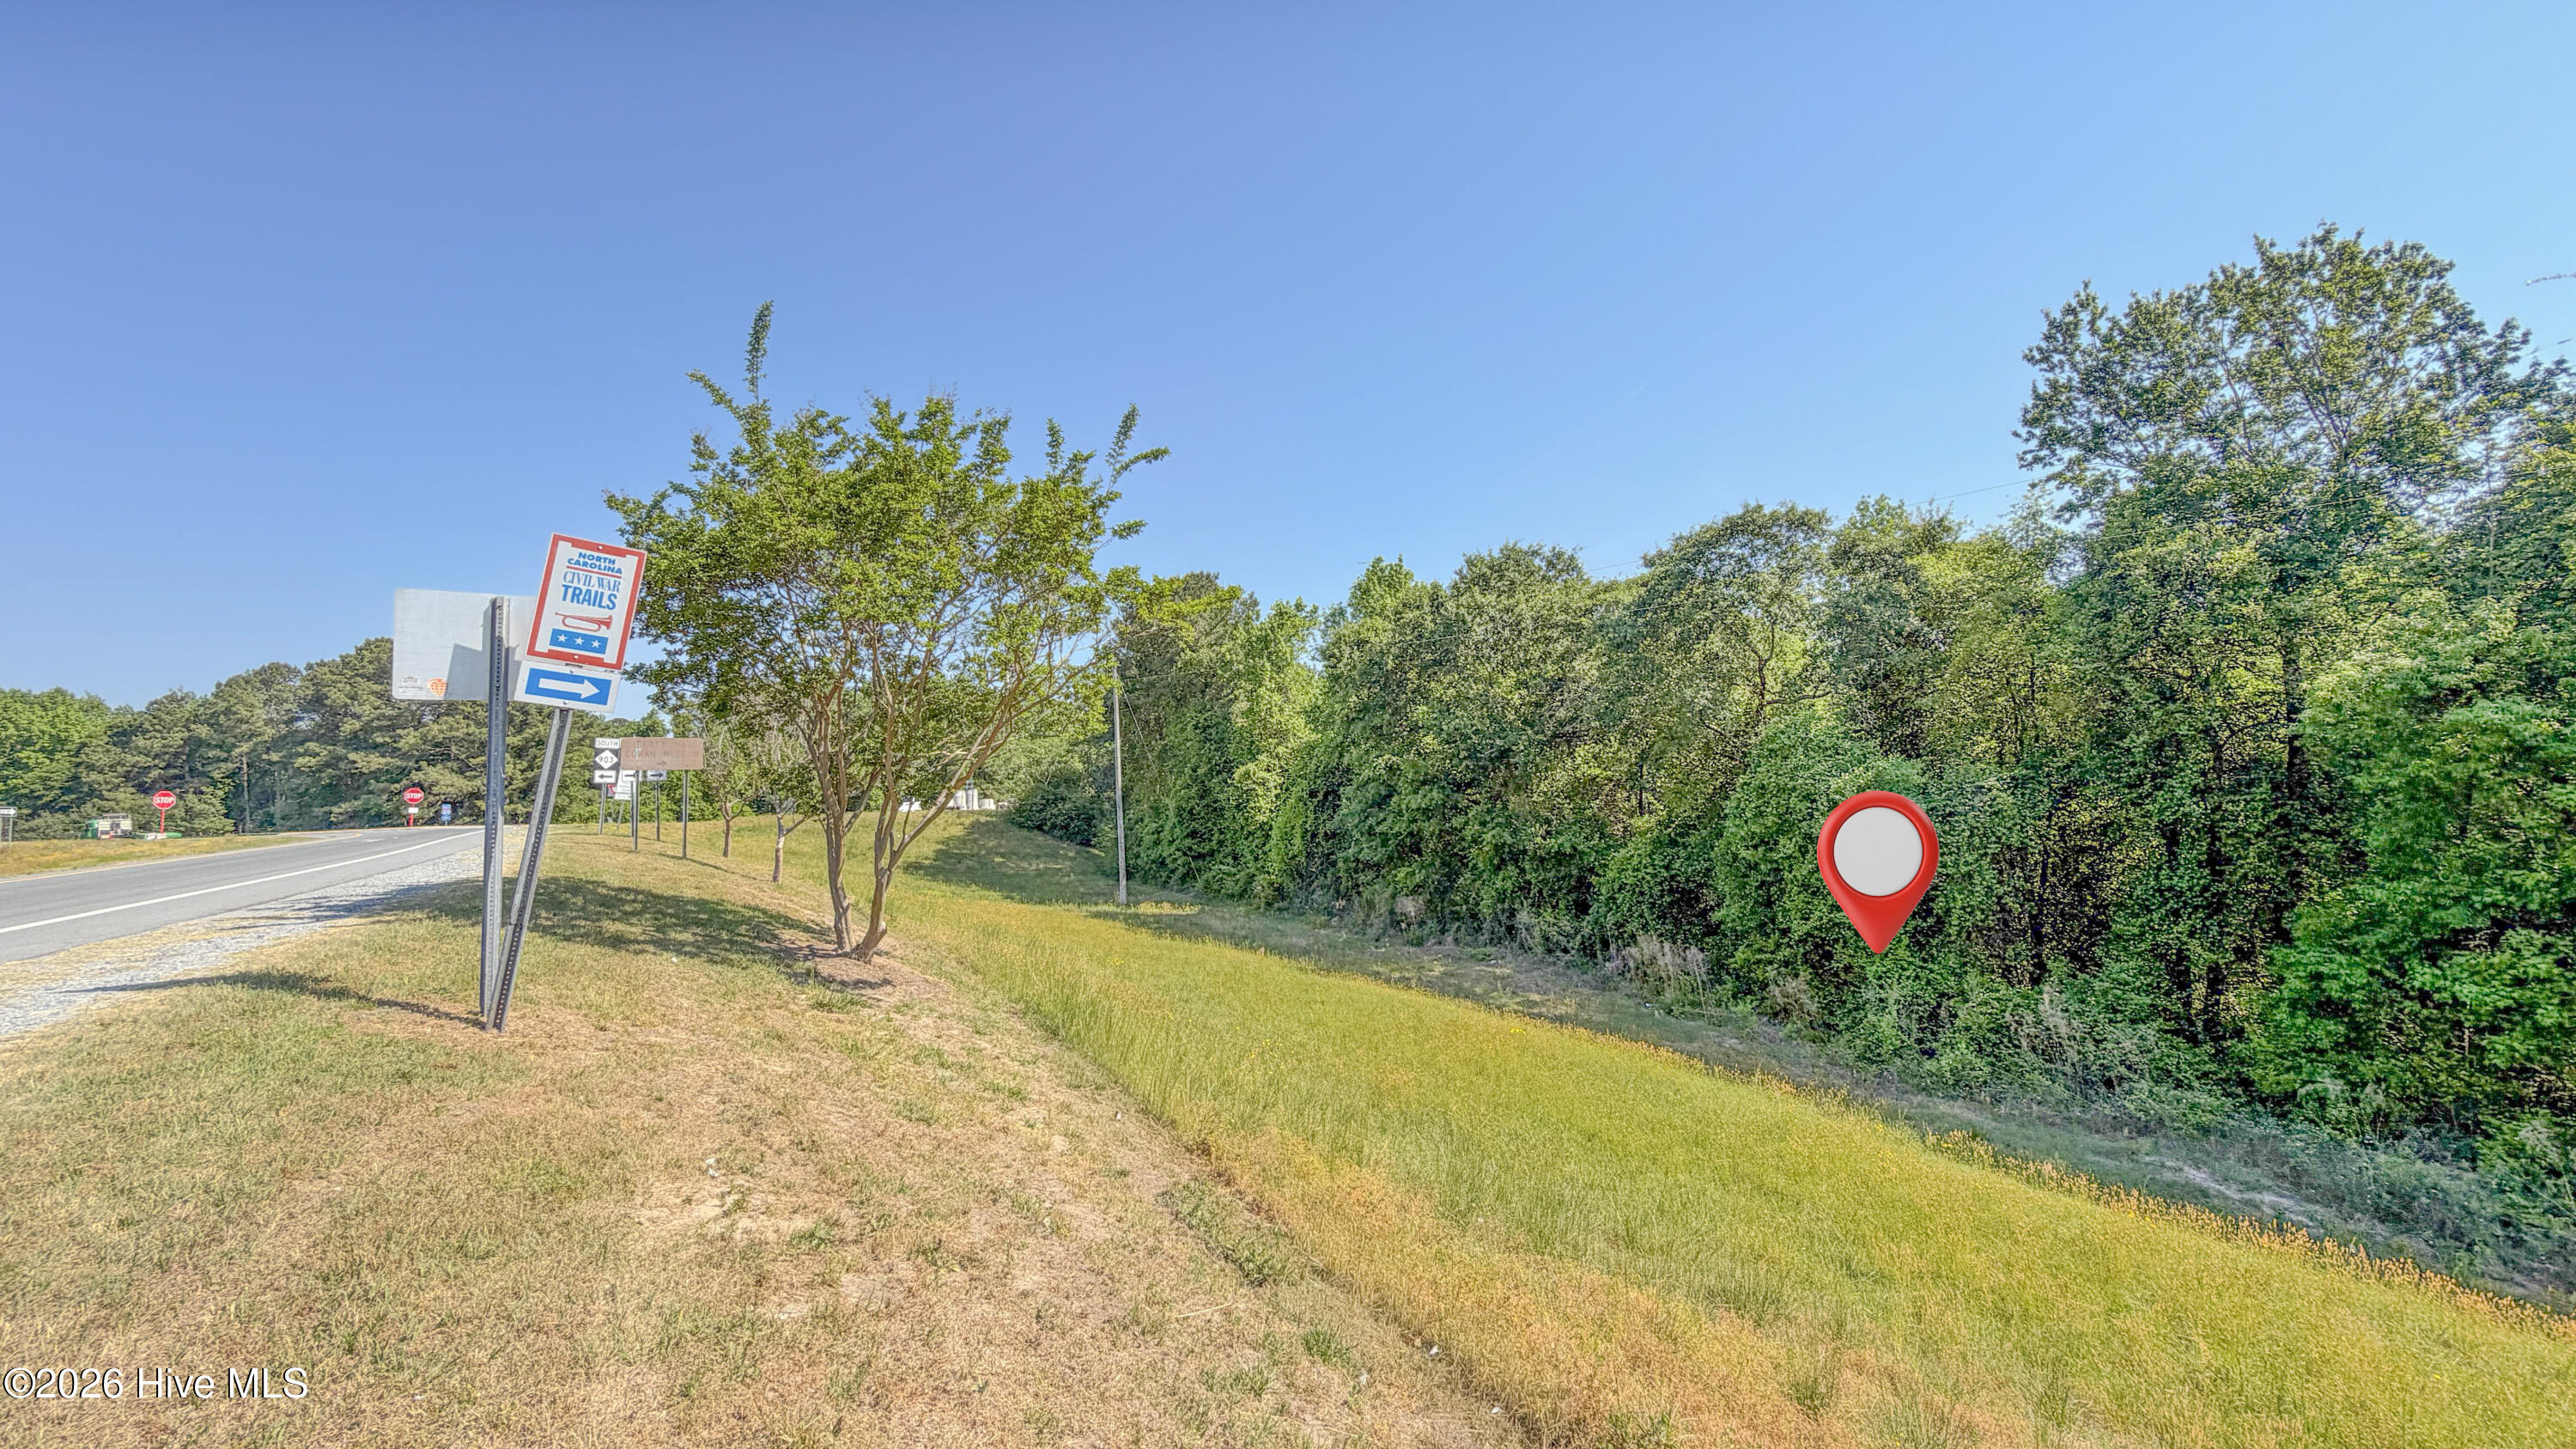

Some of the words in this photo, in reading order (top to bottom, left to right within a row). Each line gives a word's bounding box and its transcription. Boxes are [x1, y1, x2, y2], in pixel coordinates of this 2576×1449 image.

[567, 557, 623, 575] CAROLINA
[578, 551, 616, 565] NORTH
[563, 570, 594, 588] CIVIL
[597, 576, 622, 593] WAR
[562, 584, 617, 610] TRAILS
